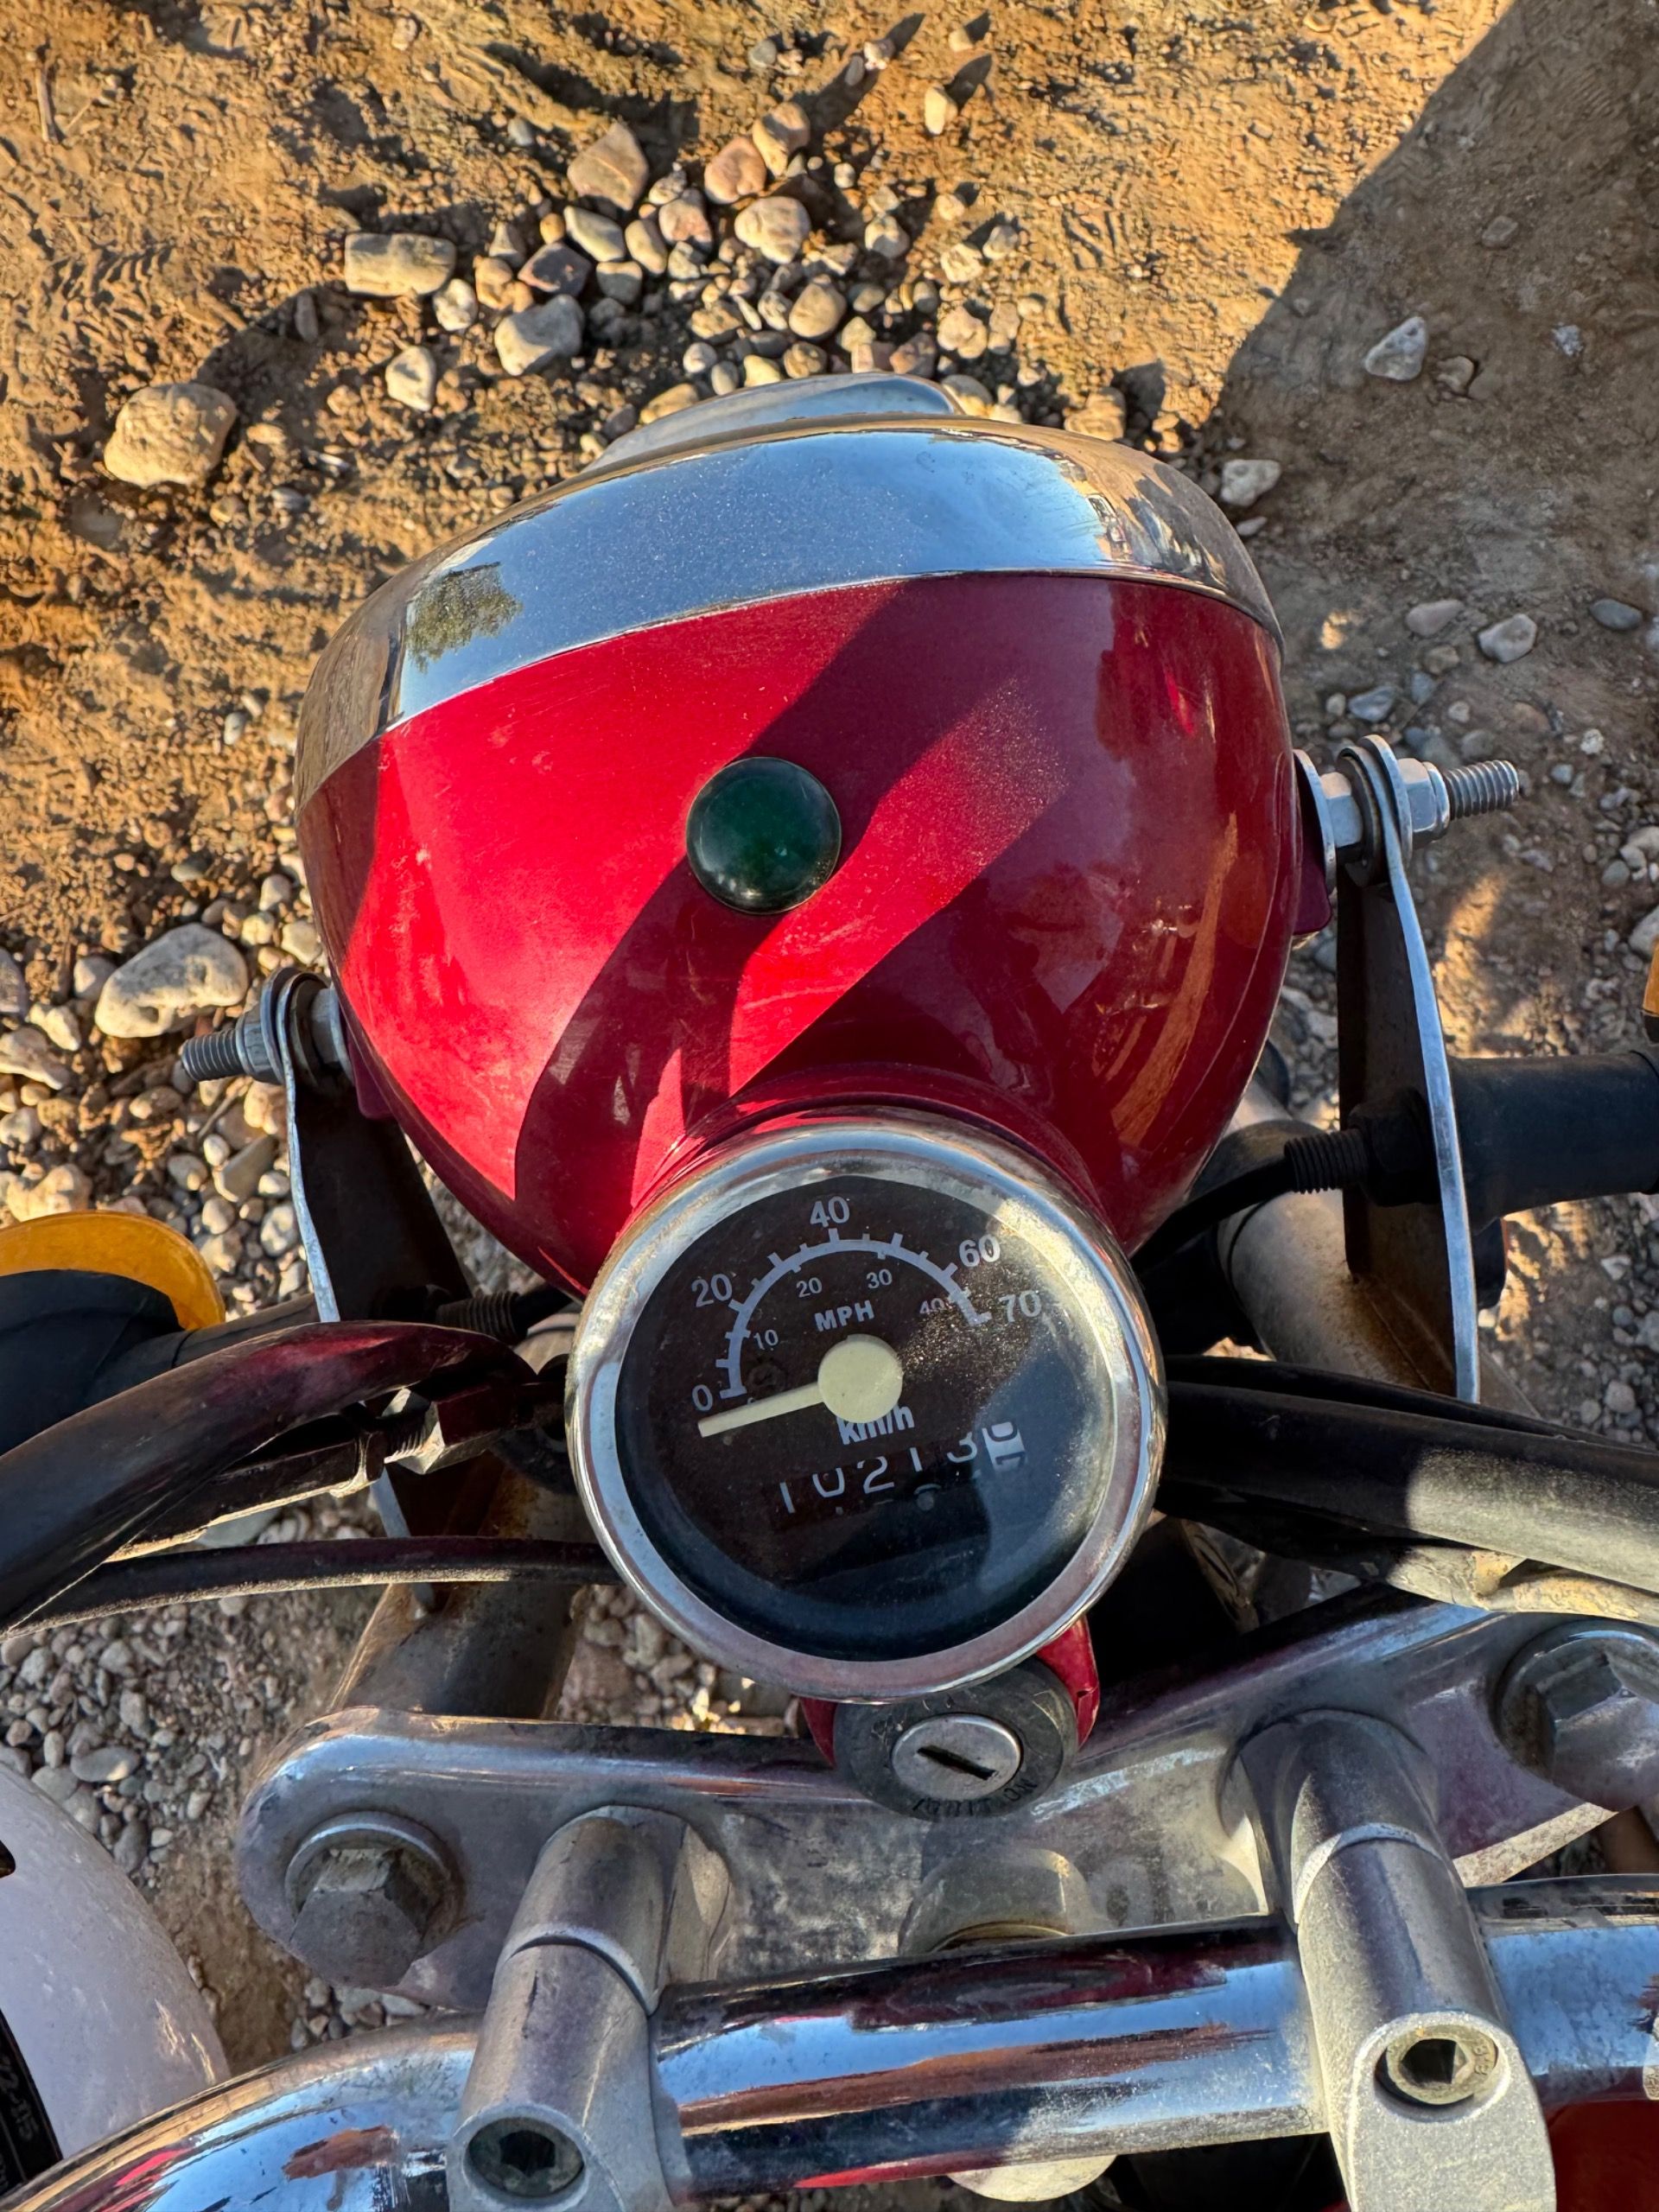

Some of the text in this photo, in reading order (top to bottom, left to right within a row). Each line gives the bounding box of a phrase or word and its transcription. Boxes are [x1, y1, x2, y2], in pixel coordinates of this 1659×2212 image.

[810, 1196, 849, 1227] 40
[959, 1234, 1001, 1268] 60
[692, 1274, 733, 1307] 20
[796, 1277, 822, 1298] 20
[867, 1268, 892, 1289] 30
[815, 1300, 874, 1332] MPH
[919, 1298, 945, 1314] 40
[999, 1290, 1041, 1323] 70
[753, 1329, 779, 1350] 10
[692, 1384, 713, 1411] 0
